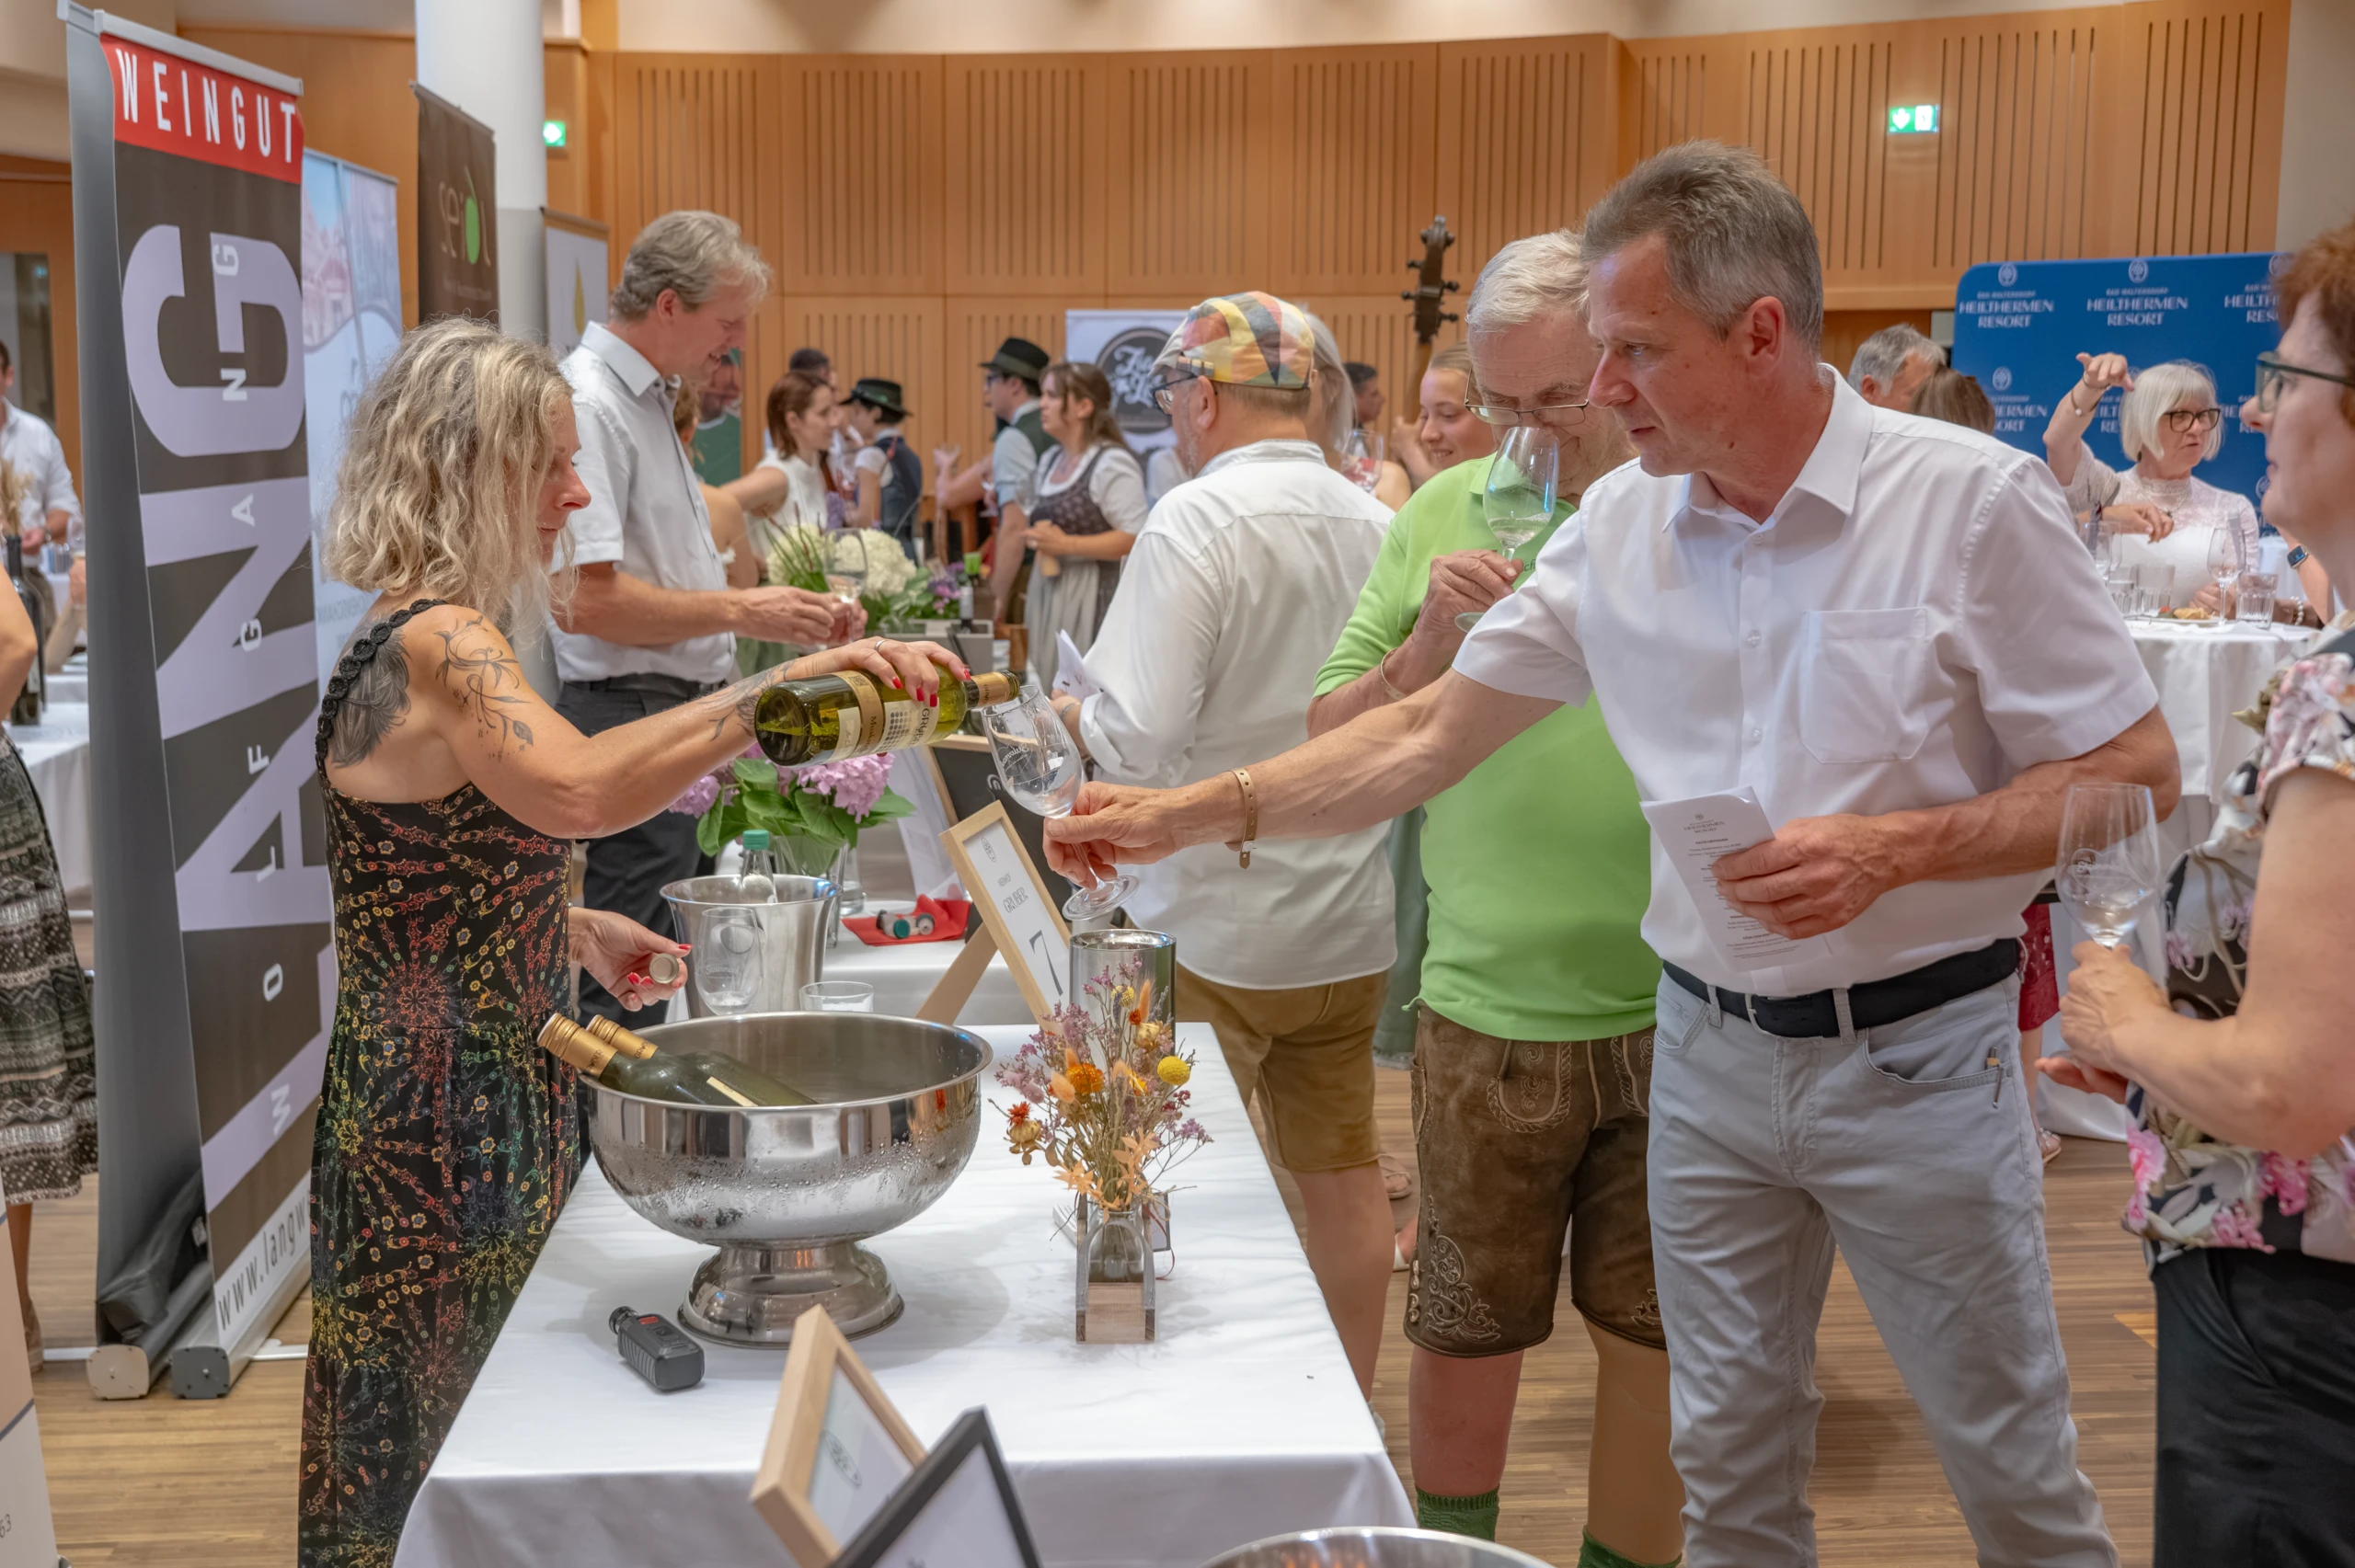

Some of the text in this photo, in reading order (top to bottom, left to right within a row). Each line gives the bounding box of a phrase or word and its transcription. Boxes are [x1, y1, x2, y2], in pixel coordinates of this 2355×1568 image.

[115, 48, 296, 164] WEINGUT
[1959, 299, 2055, 315] HEILTHERMEN
[2086, 296, 2189, 312] HEILTHERMEN
[2223, 293, 2280, 308] HEILTH
[1978, 314, 2032, 328] RESORT
[2107, 312, 2165, 326] RESORT
[2246, 309, 2280, 324] RES
[1003, 887, 1029, 913] GRUBER
[1028, 930, 1063, 996] 7
